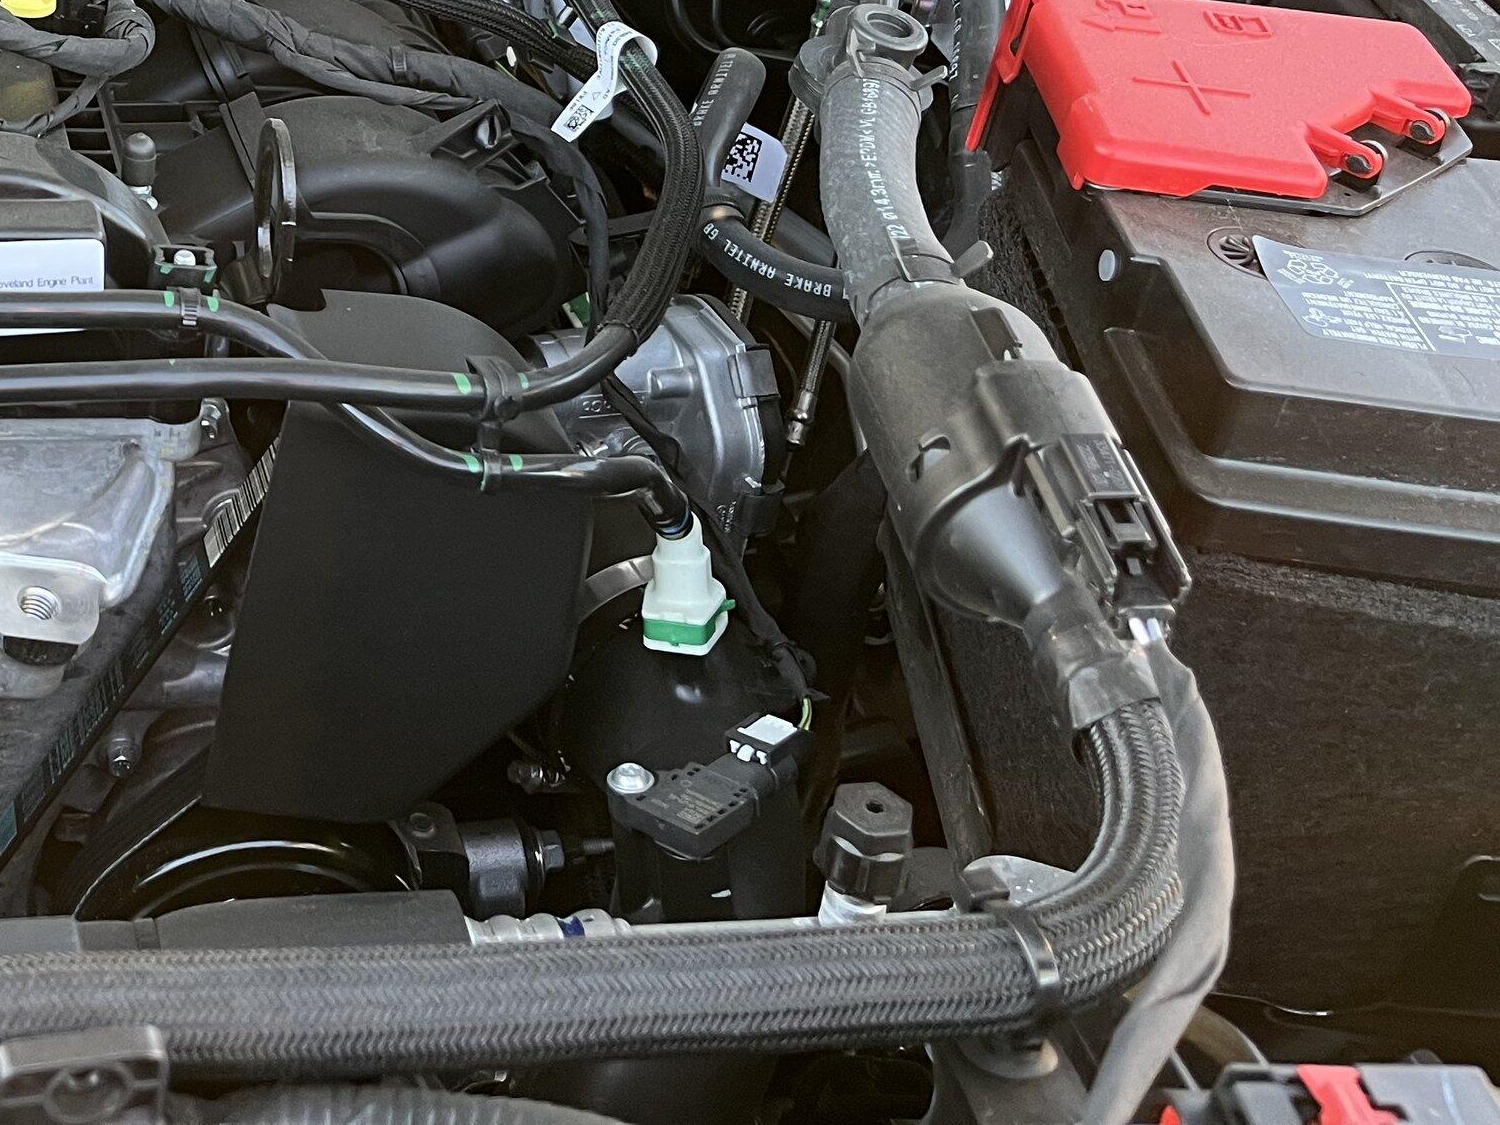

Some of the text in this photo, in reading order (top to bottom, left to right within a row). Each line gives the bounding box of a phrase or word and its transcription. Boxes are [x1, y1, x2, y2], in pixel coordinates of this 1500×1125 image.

[37, 276, 67, 289] Engine
[71, 274, 94, 286] Plant
[783, 272, 832, 298] BRAKE
